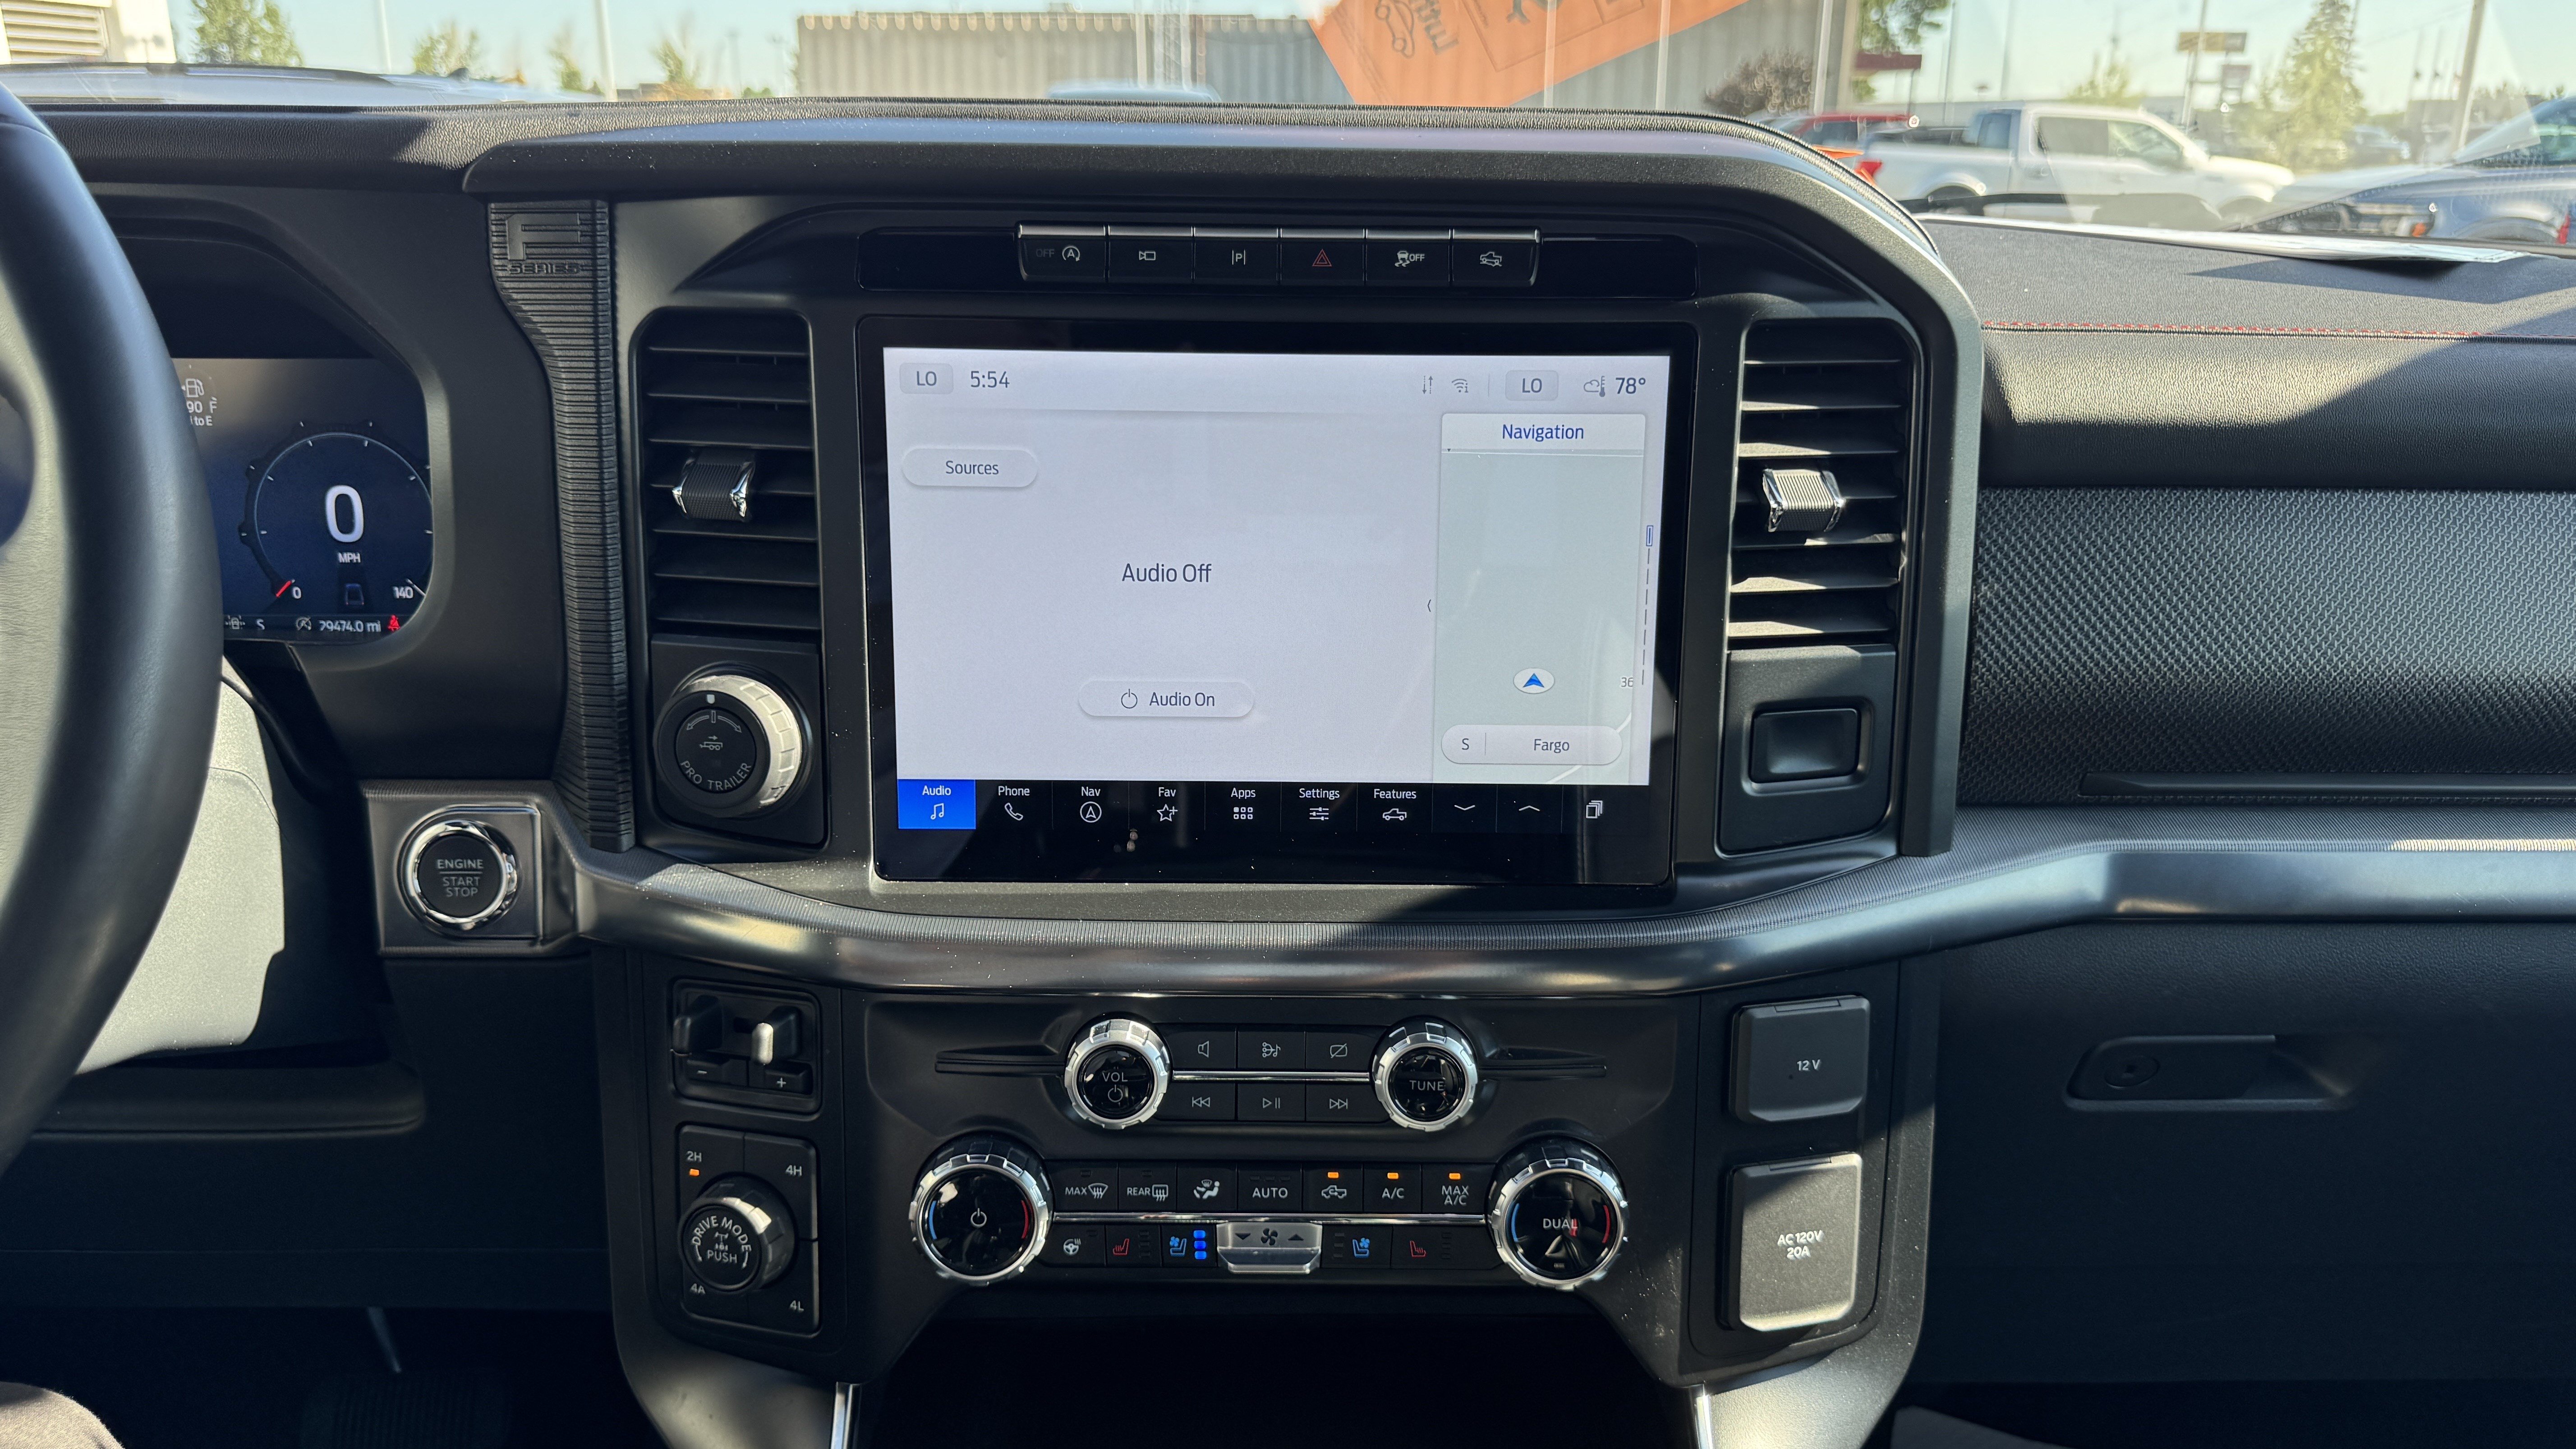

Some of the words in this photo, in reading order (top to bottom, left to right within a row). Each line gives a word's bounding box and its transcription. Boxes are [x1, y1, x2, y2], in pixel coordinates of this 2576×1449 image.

[506, 212, 580, 261] F
[1036, 248, 1055, 258] OFF
[1409, 253, 1425, 262] OFF
[508, 263, 581, 275] SERIES
[916, 371, 937, 386] LO
[970, 371, 1010, 388] 5:54
[1522, 378, 1542, 393] LO
[193, 415, 205, 426] to
[206, 415, 213, 426] E
[1502, 424, 1584, 442] Navigation
[945, 460, 999, 475] Sources
[325, 485, 364, 543] 0
[338, 552, 361, 563] MPH
[1122, 563, 1178, 583] Audio
[1182, 563, 1212, 583] Off
[292, 587, 302, 599] 0
[393, 587, 414, 599] 140
[256, 619, 265, 630] S
[366, 620, 382, 631] mi
[1149, 691, 1191, 707] Audio
[1194, 692, 1215, 707] On
[1461, 738, 1470, 750] S
[1533, 739, 1570, 753] Fargo
[680, 760, 703, 785] PRO
[707, 762, 752, 791] TRAILER
[921, 785, 952, 796] Audio
[998, 786, 1030, 796] Phone
[1081, 787, 1101, 797] Nav
[1158, 787, 1176, 797] Fav
[1231, 787, 1256, 800] Apps
[1298, 788, 1340, 800] Settings
[1373, 788, 1417, 800] Features
[437, 859, 484, 869] ENGINE
[443, 876, 480, 887] START
[446, 887, 478, 897] STOP
[1102, 1072, 1128, 1082] VOL
[1409, 1080, 1444, 1091] TUNE
[686, 1150, 702, 1162] 2H
[785, 1164, 803, 1176] 4H
[1065, 1187, 1087, 1196] MAX
[1127, 1187, 1150, 1196] REAR
[1252, 1187, 1288, 1199] AUTO
[1381, 1187, 1405, 1200] A/C
[1441, 1185, 1469, 1195] MAX
[1444, 1195, 1467, 1206] A/C
[1542, 1218, 1578, 1230] DUAL
[692, 1215, 719, 1247] DRIVE
[721, 1217, 752, 1252] MODE
[707, 1250, 738, 1263] PUSH
[1787, 1246, 1811, 1260] 20A
[690, 1283, 706, 1295] 4A
[789, 1300, 804, 1312] 4L
